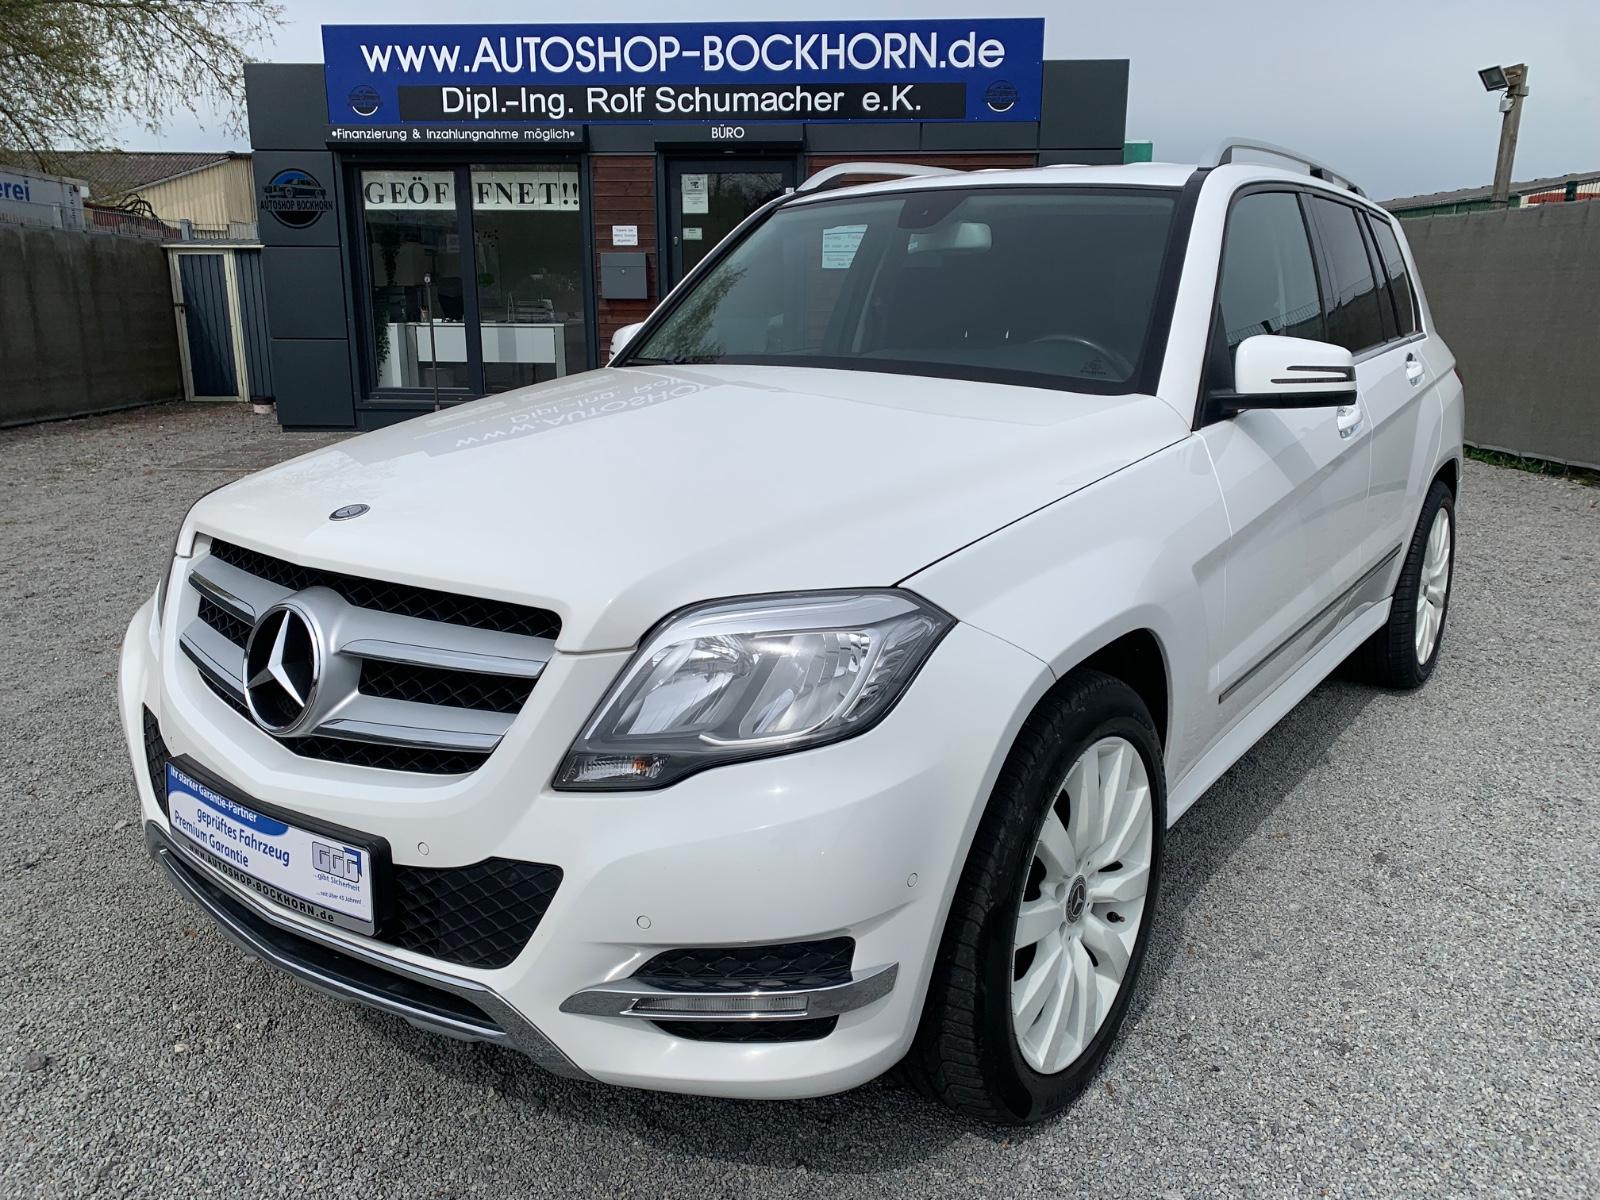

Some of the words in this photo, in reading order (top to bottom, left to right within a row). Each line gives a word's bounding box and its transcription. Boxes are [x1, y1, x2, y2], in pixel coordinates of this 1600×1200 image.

[359, 31, 1006, 73] www.AUTOSHOP-BOCKHORN.de
[441, 87, 574, 119] Dipl.-Ing.
[586, 86, 647, 113] Rolf
[654, 85, 845, 113] Schumacher
[861, 84, 922, 112] e.K.
[412, 128, 421, 140] &
[426, 128, 519, 142] Inzahlungnahme
[710, 123, 745, 139] BÜRO
[260, 200, 295, 210] AUTOSHOP
[296, 200, 334, 210] BOCKHORN
[364, 176, 450, 205] GEÖF
[476, 181, 579, 206] FNET!!
[170, 766, 178, 779] Ihr
[178, 772, 199, 791] starker
[199, 785, 257, 823] Garantie-Partner
[174, 810, 208, 844] Premium
[209, 833, 249, 867] Garantie
[197, 808, 237, 841] geprüftes
[239, 828, 290, 867] Fahrzeug
